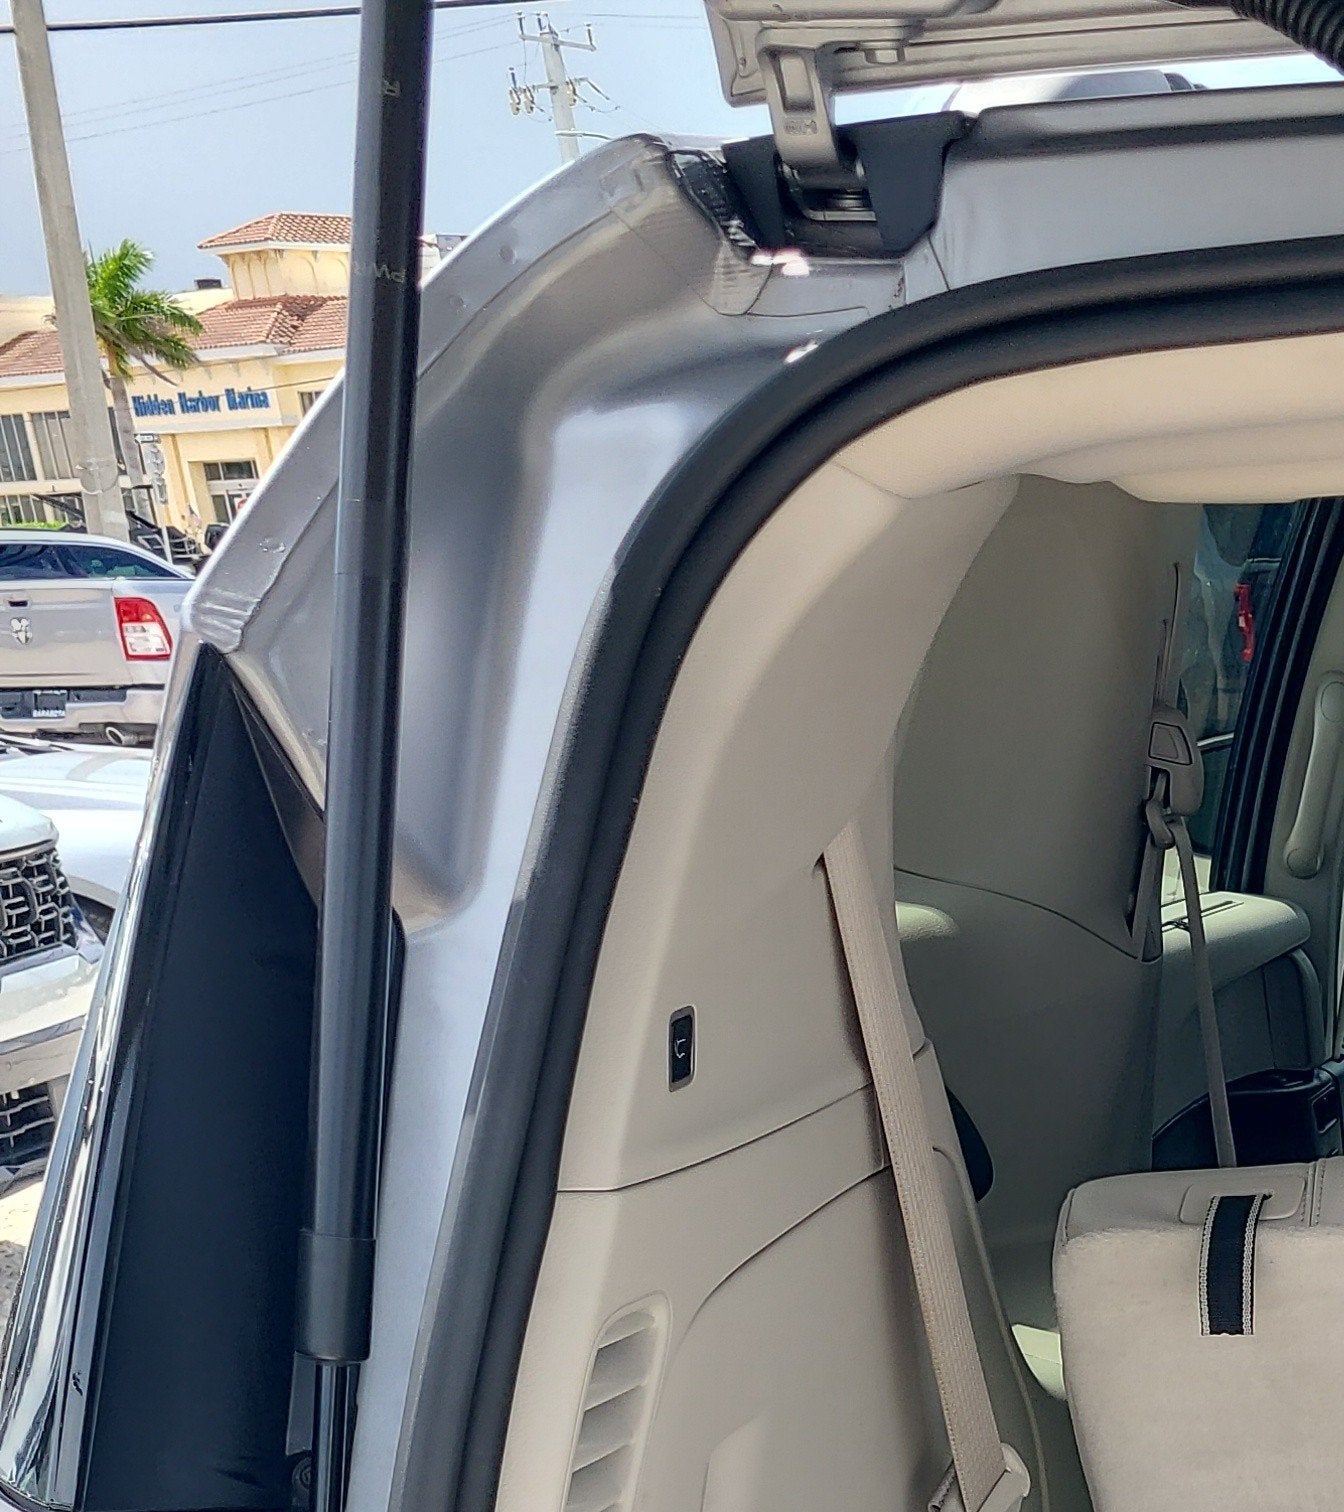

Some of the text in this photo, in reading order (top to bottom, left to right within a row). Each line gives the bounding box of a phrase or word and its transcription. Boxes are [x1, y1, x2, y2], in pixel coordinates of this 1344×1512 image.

[131, 387, 270, 417] Hidden Harbor Marina
